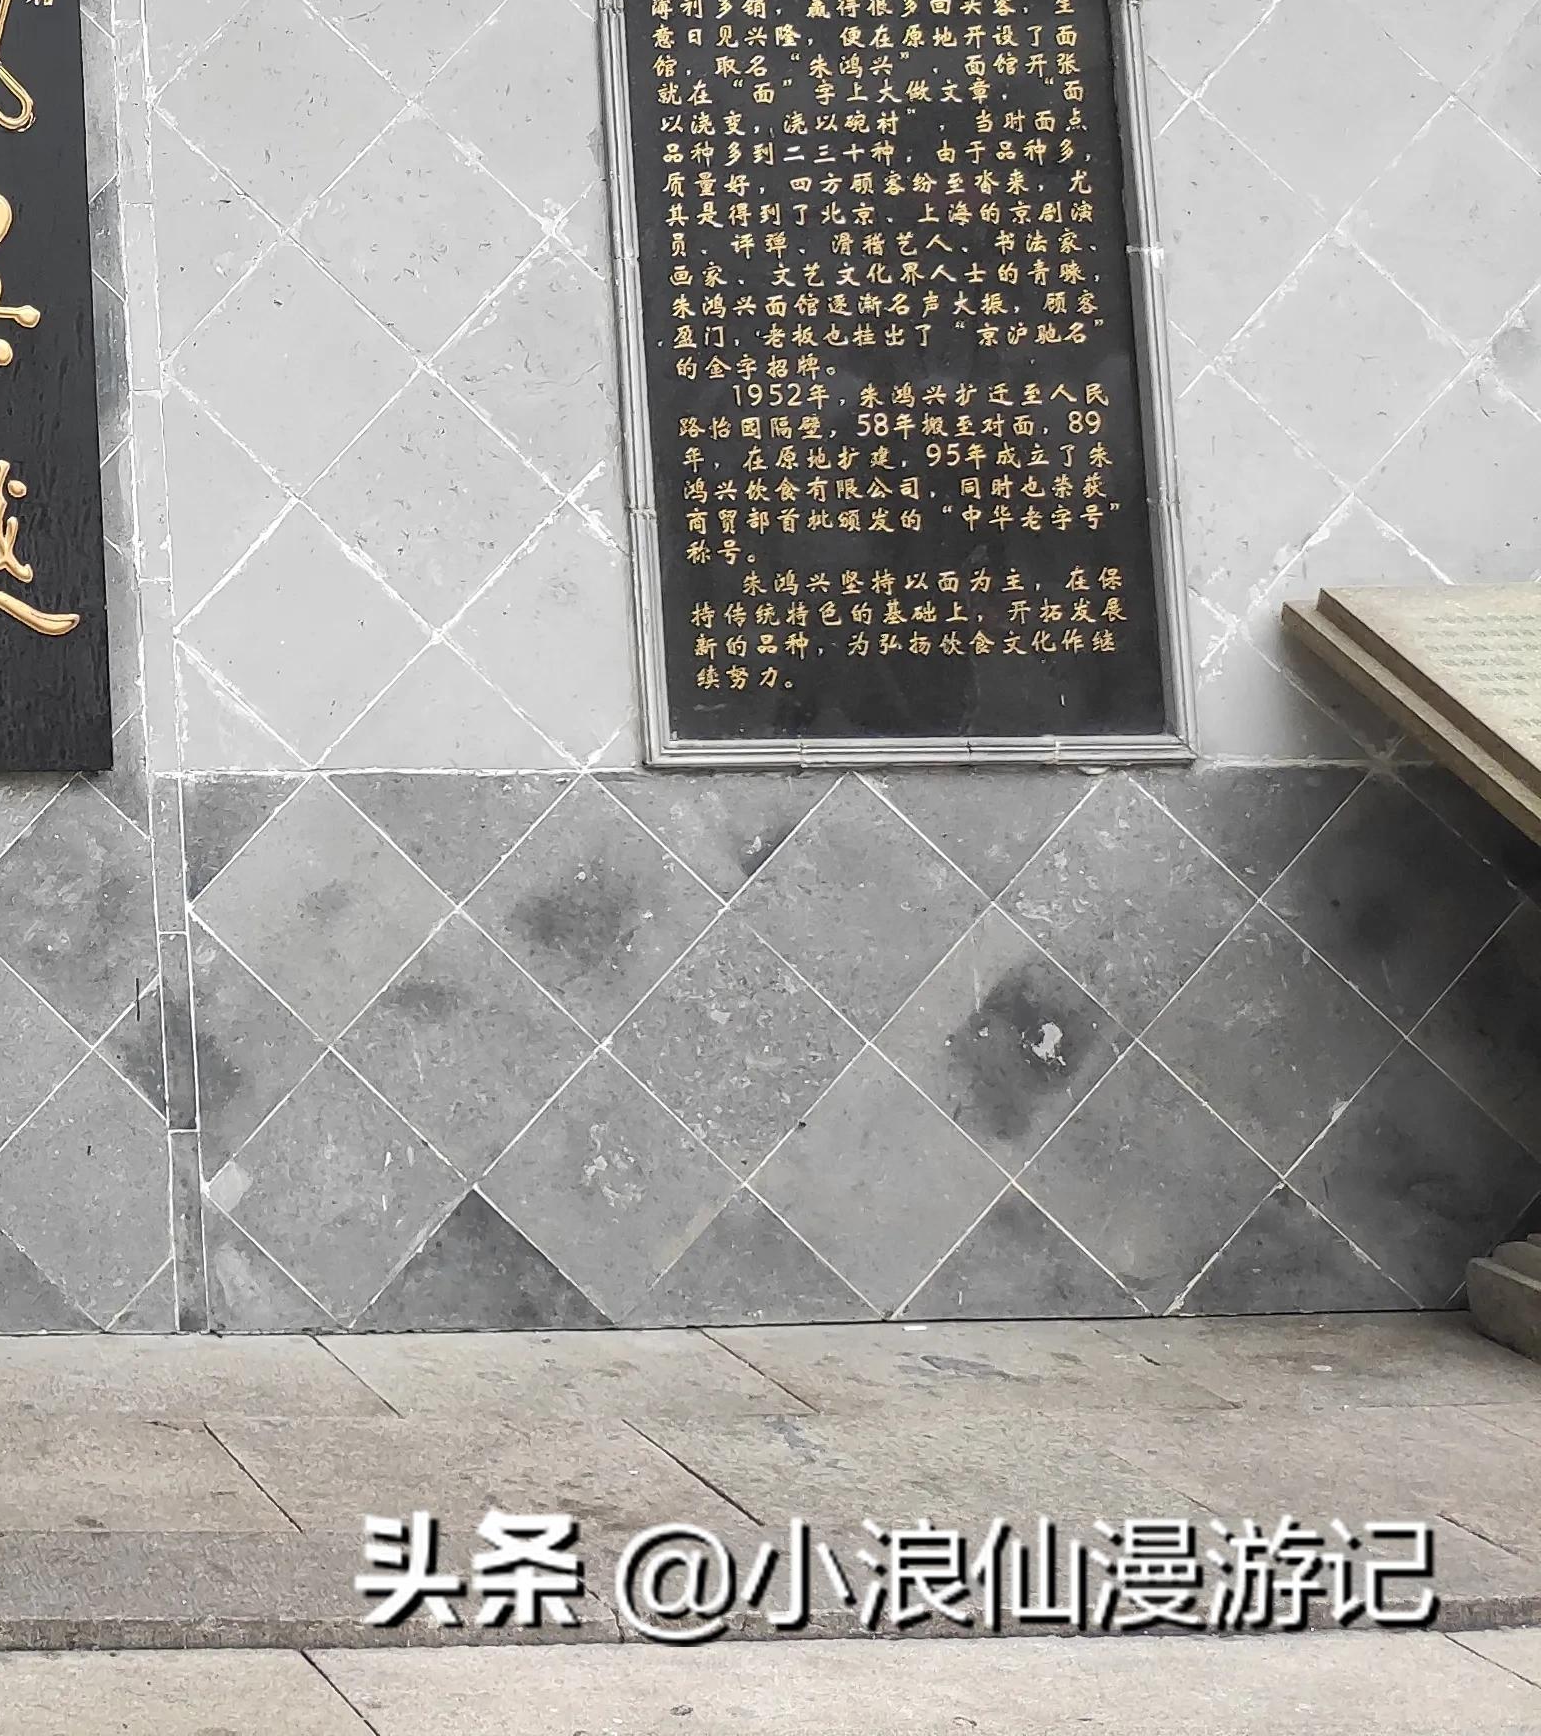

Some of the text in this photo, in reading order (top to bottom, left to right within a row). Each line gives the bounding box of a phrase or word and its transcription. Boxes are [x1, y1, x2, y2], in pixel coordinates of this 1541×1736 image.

[676, 352, 837, 381] 的金字招牌。
[686, 538, 756, 566] 称号。
[742, 567, 1123, 597] 朱鸿兴坚持以面为主，在保
[691, 597, 1127, 629] 持传统特色的基础上，开拓发展
[696, 664, 793, 690] 续努力。
